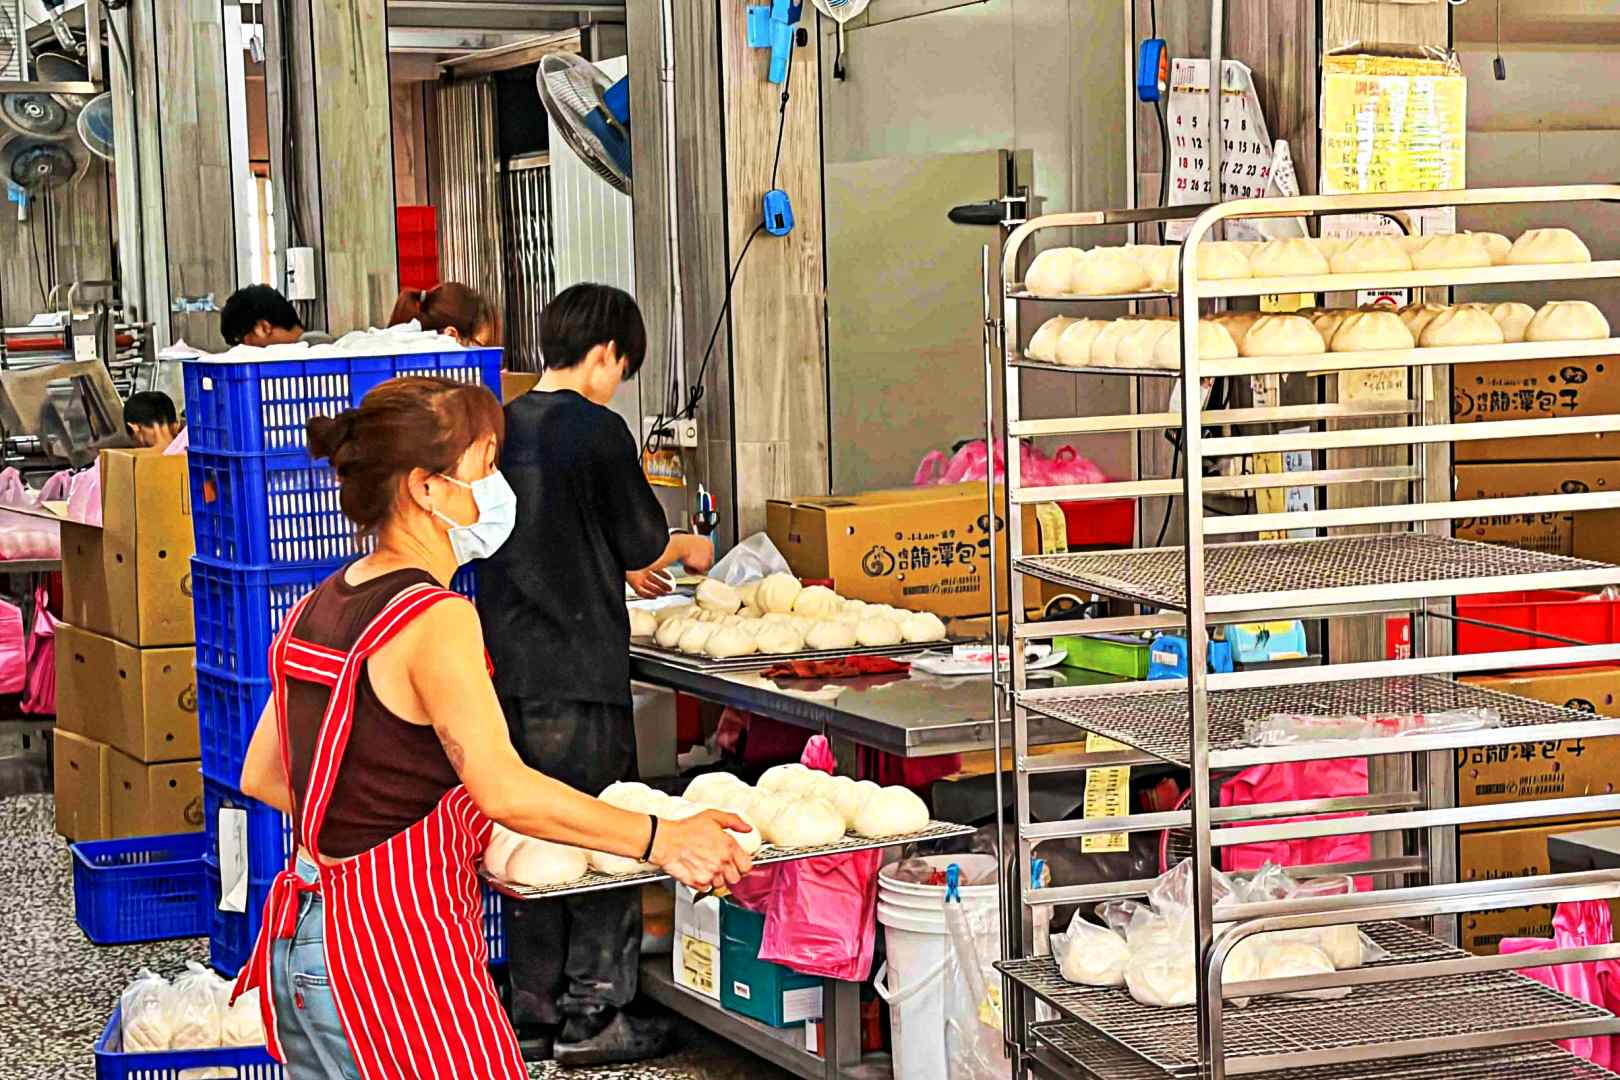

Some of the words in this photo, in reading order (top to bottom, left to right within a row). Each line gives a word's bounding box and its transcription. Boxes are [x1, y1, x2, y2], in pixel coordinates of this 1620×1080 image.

[1176, 115, 1182, 126] 4
[1192, 116, 1197, 128] 5
[1224, 119, 1229, 130] 7
[1241, 120, 1246, 131] 8
[1176, 136, 1185, 147] 11
[1192, 137, 1202, 149] 12
[1224, 140, 1233, 152] 14
[1239, 141, 1247, 153] 15
[1252, 142, 1260, 154] 16
[1178, 157, 1188, 168] 18
[1194, 158, 1203, 169] 19
[1232, 163, 1243, 174] 22
[1246, 165, 1257, 176] 23
[1261, 166, 1270, 178] 24
[1177, 178, 1186, 189] 25
[1190, 180, 1199, 191] 26
[1230, 184, 1239, 196] 29
[1242, 186, 1251, 198] 30
[1254, 187, 1265, 198] 31
[1490, 388, 1579, 412] 龍潭包子
